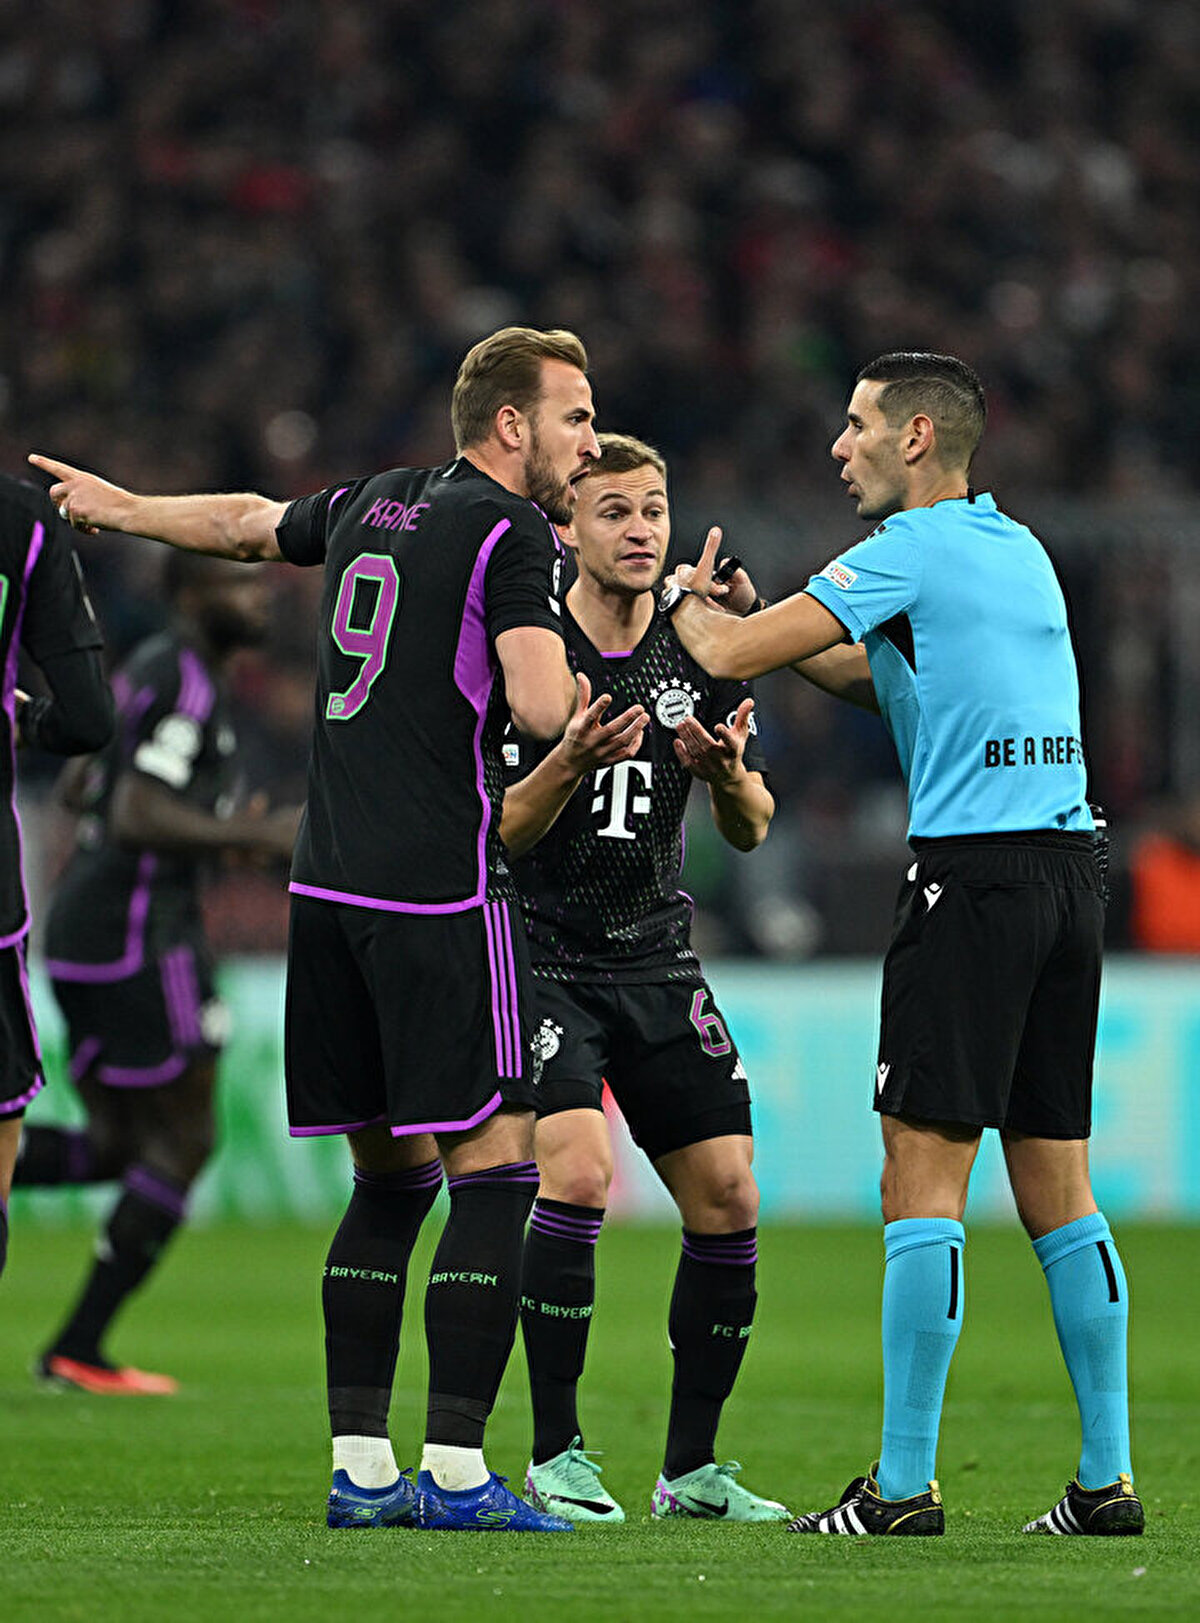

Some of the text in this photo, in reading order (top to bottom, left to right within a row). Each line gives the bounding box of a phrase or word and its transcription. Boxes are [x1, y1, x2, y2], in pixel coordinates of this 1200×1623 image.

[361, 497, 431, 531] KANE
[326, 552, 400, 720] 9
[984, 738, 1016, 768] BE
[1023, 736, 1036, 765] A
[689, 988, 731, 1057] 6
[330, 1266, 398, 1283] BAYERN
[431, 1272, 498, 1286] BAYERN
[712, 1324, 734, 1337] FC
